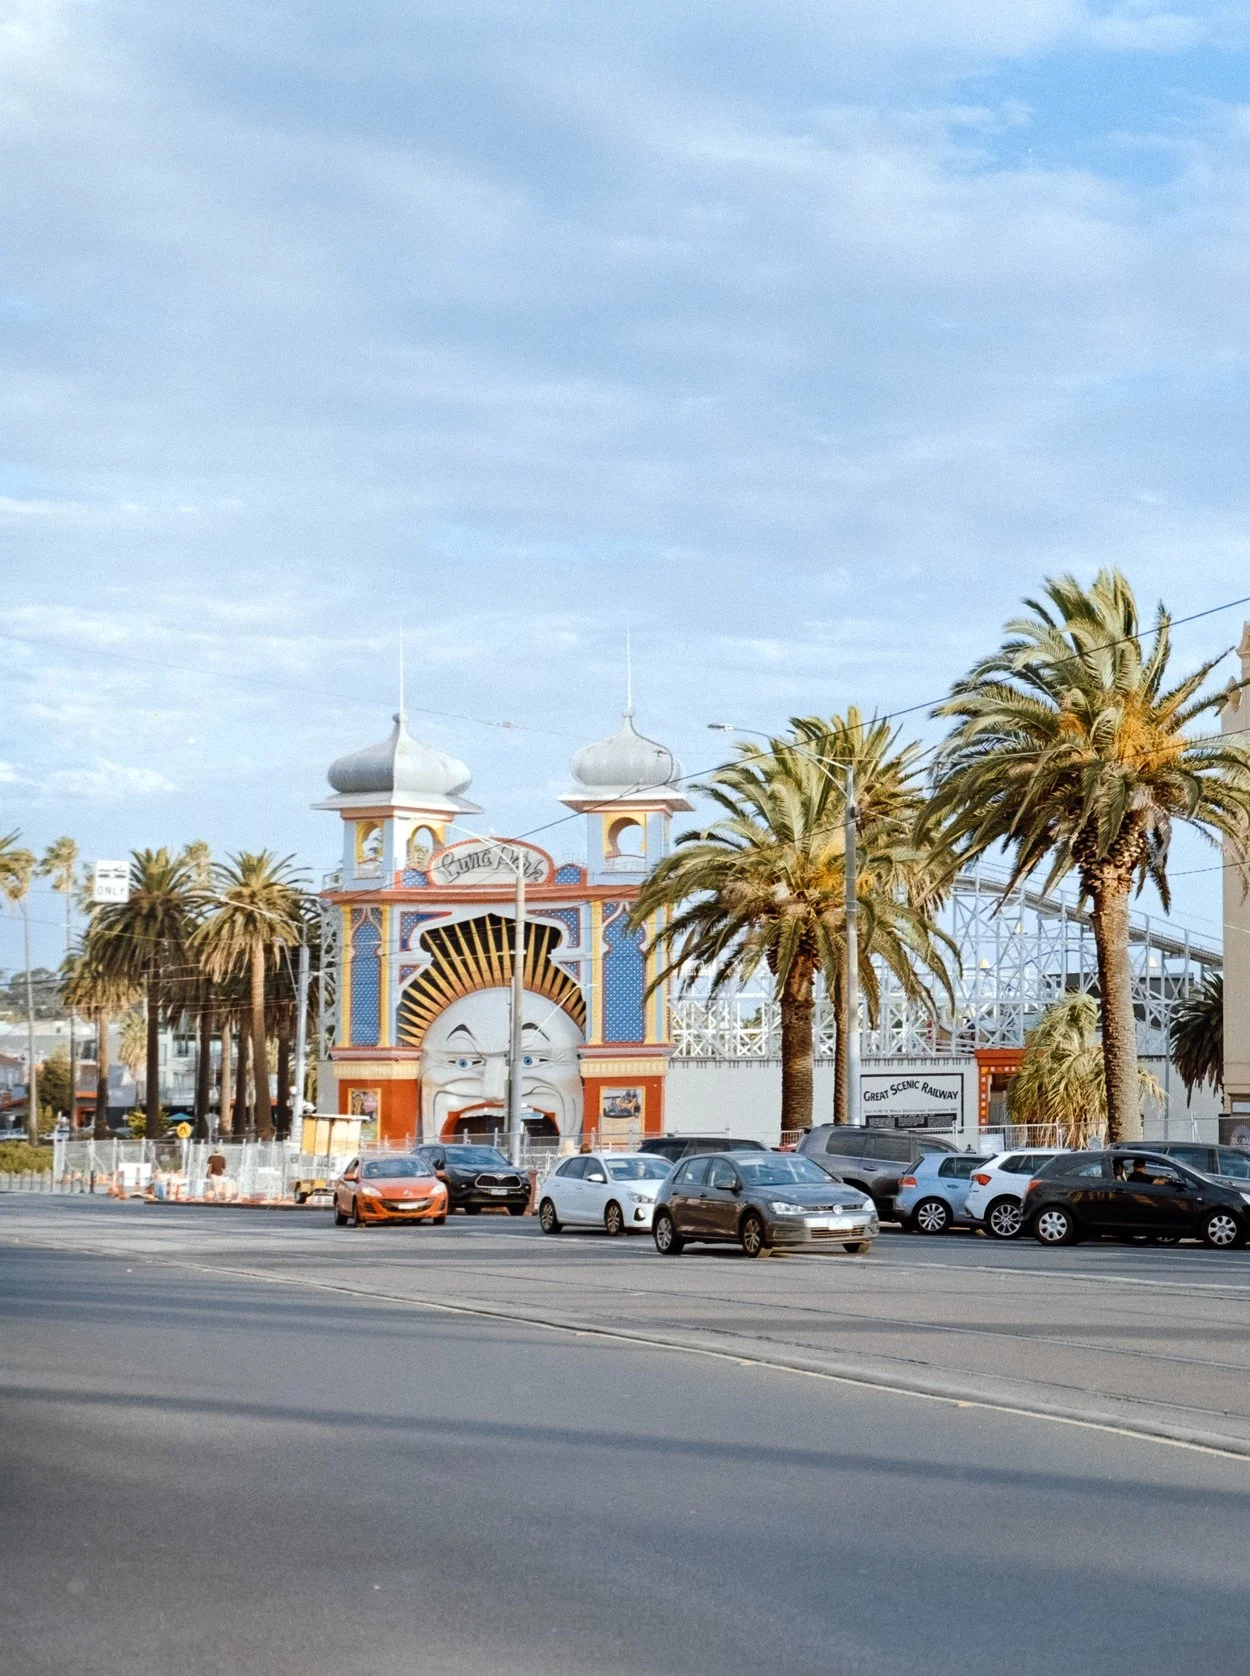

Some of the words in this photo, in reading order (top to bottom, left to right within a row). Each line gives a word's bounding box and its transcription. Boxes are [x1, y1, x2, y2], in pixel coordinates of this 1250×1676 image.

[97, 886, 125, 896] ONLY
[863, 1090, 889, 1101] GREAT
[890, 1080, 920, 1095] SCENIC
[921, 1082, 958, 1099] RAILWAY
